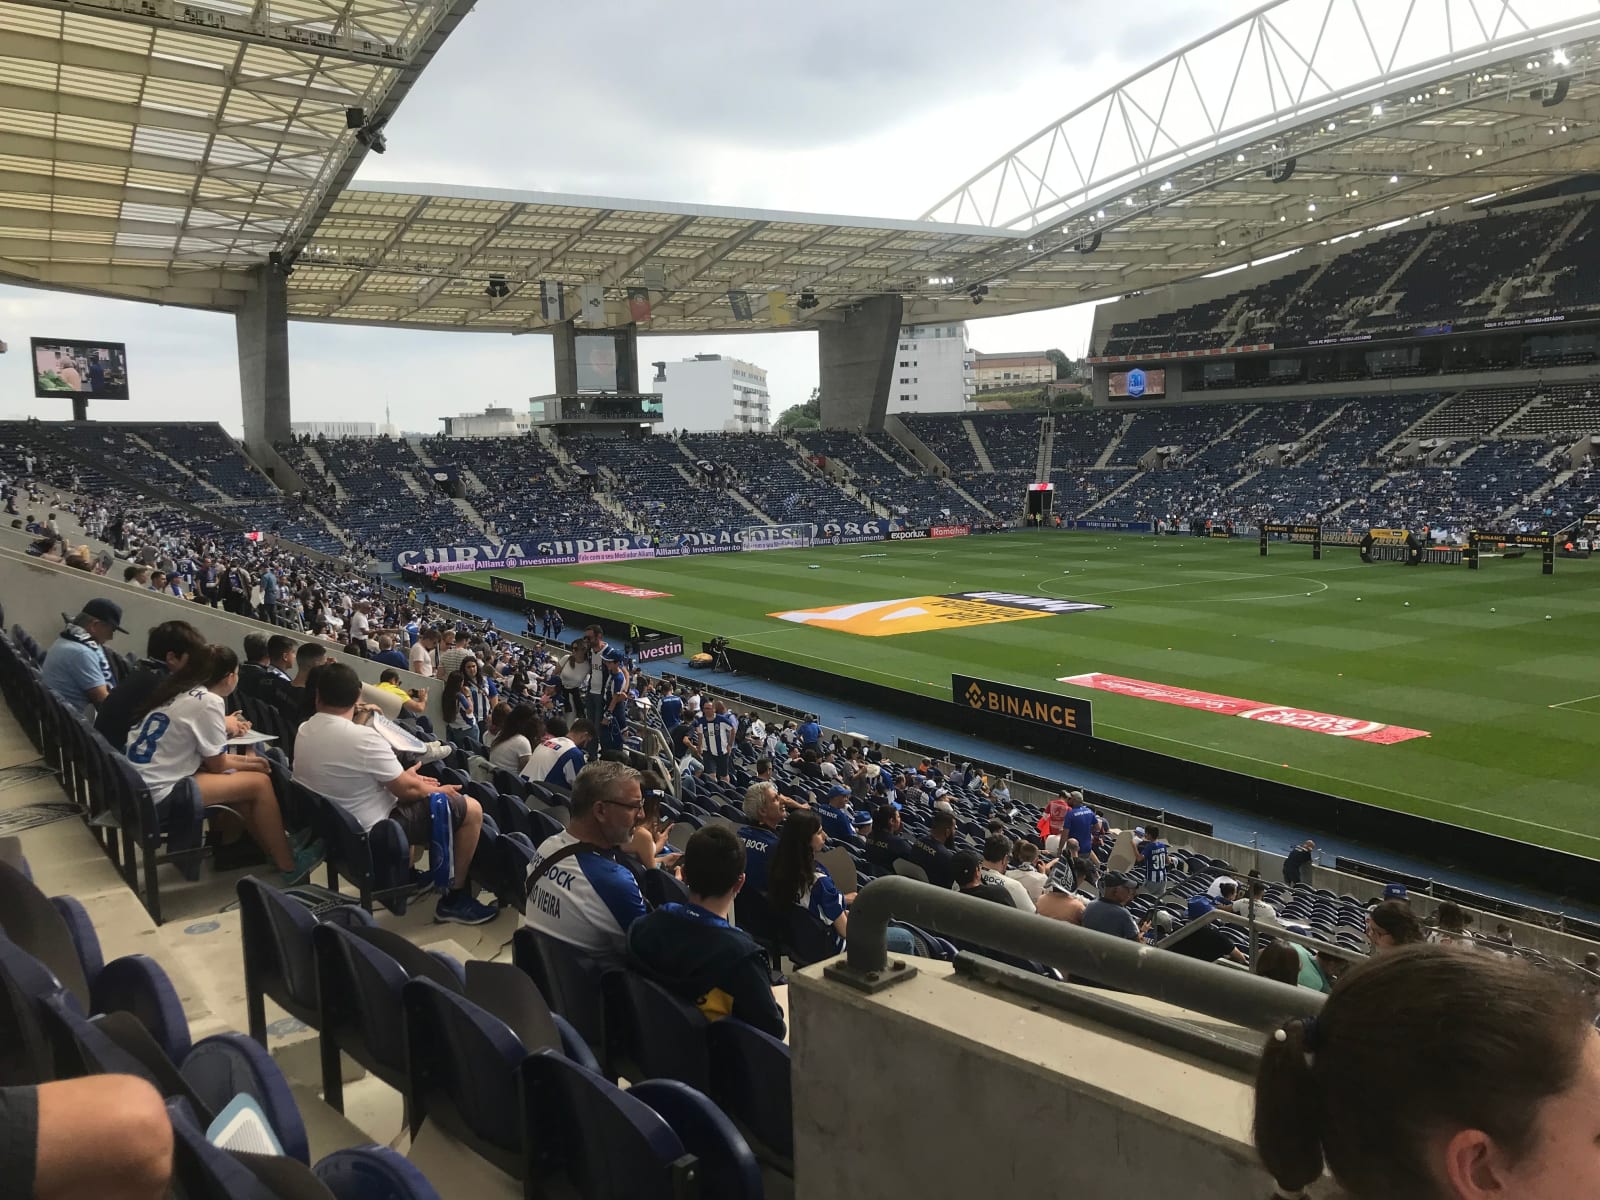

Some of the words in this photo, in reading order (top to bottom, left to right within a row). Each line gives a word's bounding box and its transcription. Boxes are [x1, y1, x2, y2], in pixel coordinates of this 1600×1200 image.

[841, 534, 885, 543] Investimento
[398, 543, 526, 567] CURVA
[537, 537, 630, 556] SUPER
[655, 548, 680, 556] Allianz
[692, 545, 741, 554] Investimento
[476, 560, 505, 569] Allianz
[519, 555, 576, 566] Investimento
[188, 689, 207, 701] CK
[987, 692, 1078, 729] BINANCE
[127, 711, 171, 764] 8
[745, 839, 769, 853] BOCK
[537, 887, 561, 919] VIEIRA
